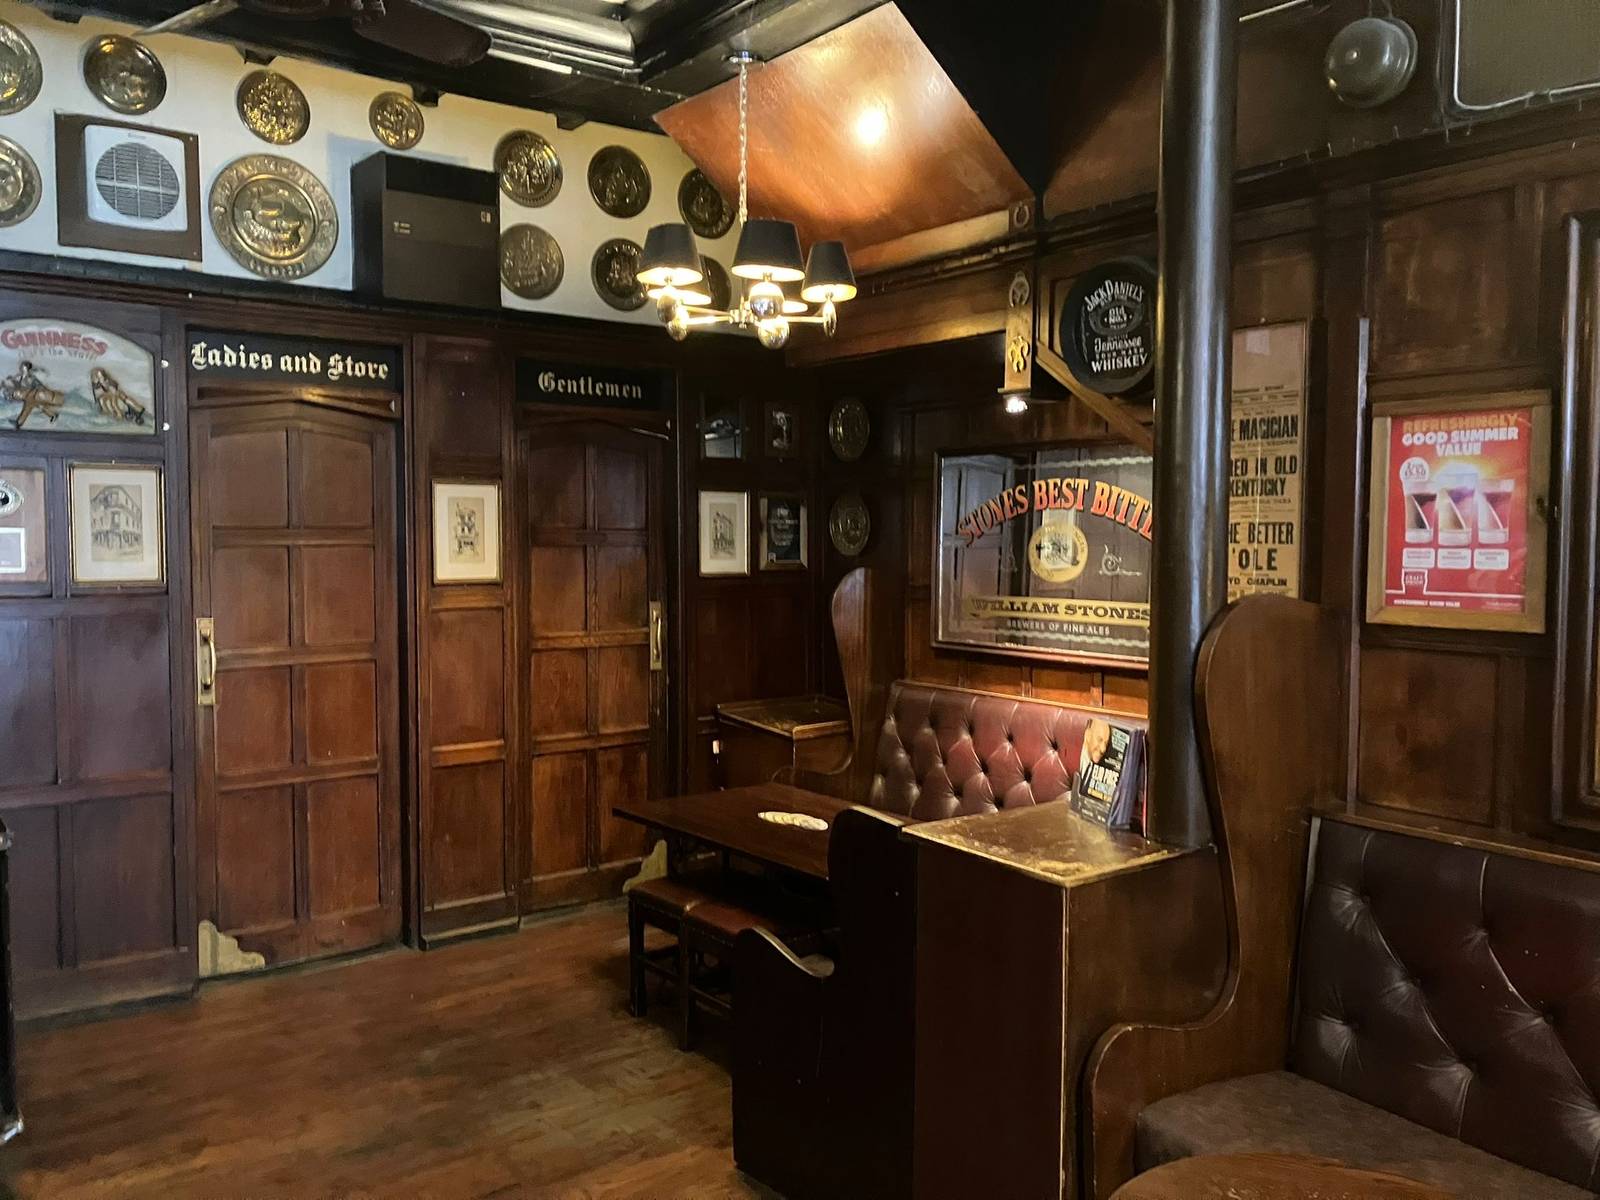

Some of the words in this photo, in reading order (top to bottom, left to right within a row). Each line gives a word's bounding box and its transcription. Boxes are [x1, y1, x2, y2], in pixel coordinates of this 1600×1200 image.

[1084, 286, 1107, 312] JACK
[1105, 280, 1144, 302] DANIEL'S
[1, 329, 108, 355] GUINNESS
[1094, 336, 1142, 353] Tennessee
[191, 342, 273, 371] Ladies
[280, 352, 321, 374] and
[327, 354, 389, 381] Store
[1091, 352, 1147, 373] WHISKEY
[538, 371, 642, 400] Gentlemen
[1239, 414, 1298, 441] MAGICIAN
[1402, 414, 1518, 433] REFRESHINGLY
[1402, 431, 1448, 446] GOOD
[1451, 426, 1518, 443] SUMMER
[1436, 441, 1482, 456] VALUE
[1274, 455, 1297, 474] OLD
[958, 484, 1028, 547] STONES
[1033, 478, 1090, 511] BEST
[1248, 521, 1294, 545] BETTER
[1247, 577, 1288, 587] CHAPLIN
[971, 598, 1059, 615] WILLIAM
[1064, 604, 1150, 620] STONES
[1007, 619, 1045, 630] BREWERS
[1049, 622, 1059, 631] OF
[1064, 623, 1084, 633] FINE
[1087, 625, 1110, 636] ALES
